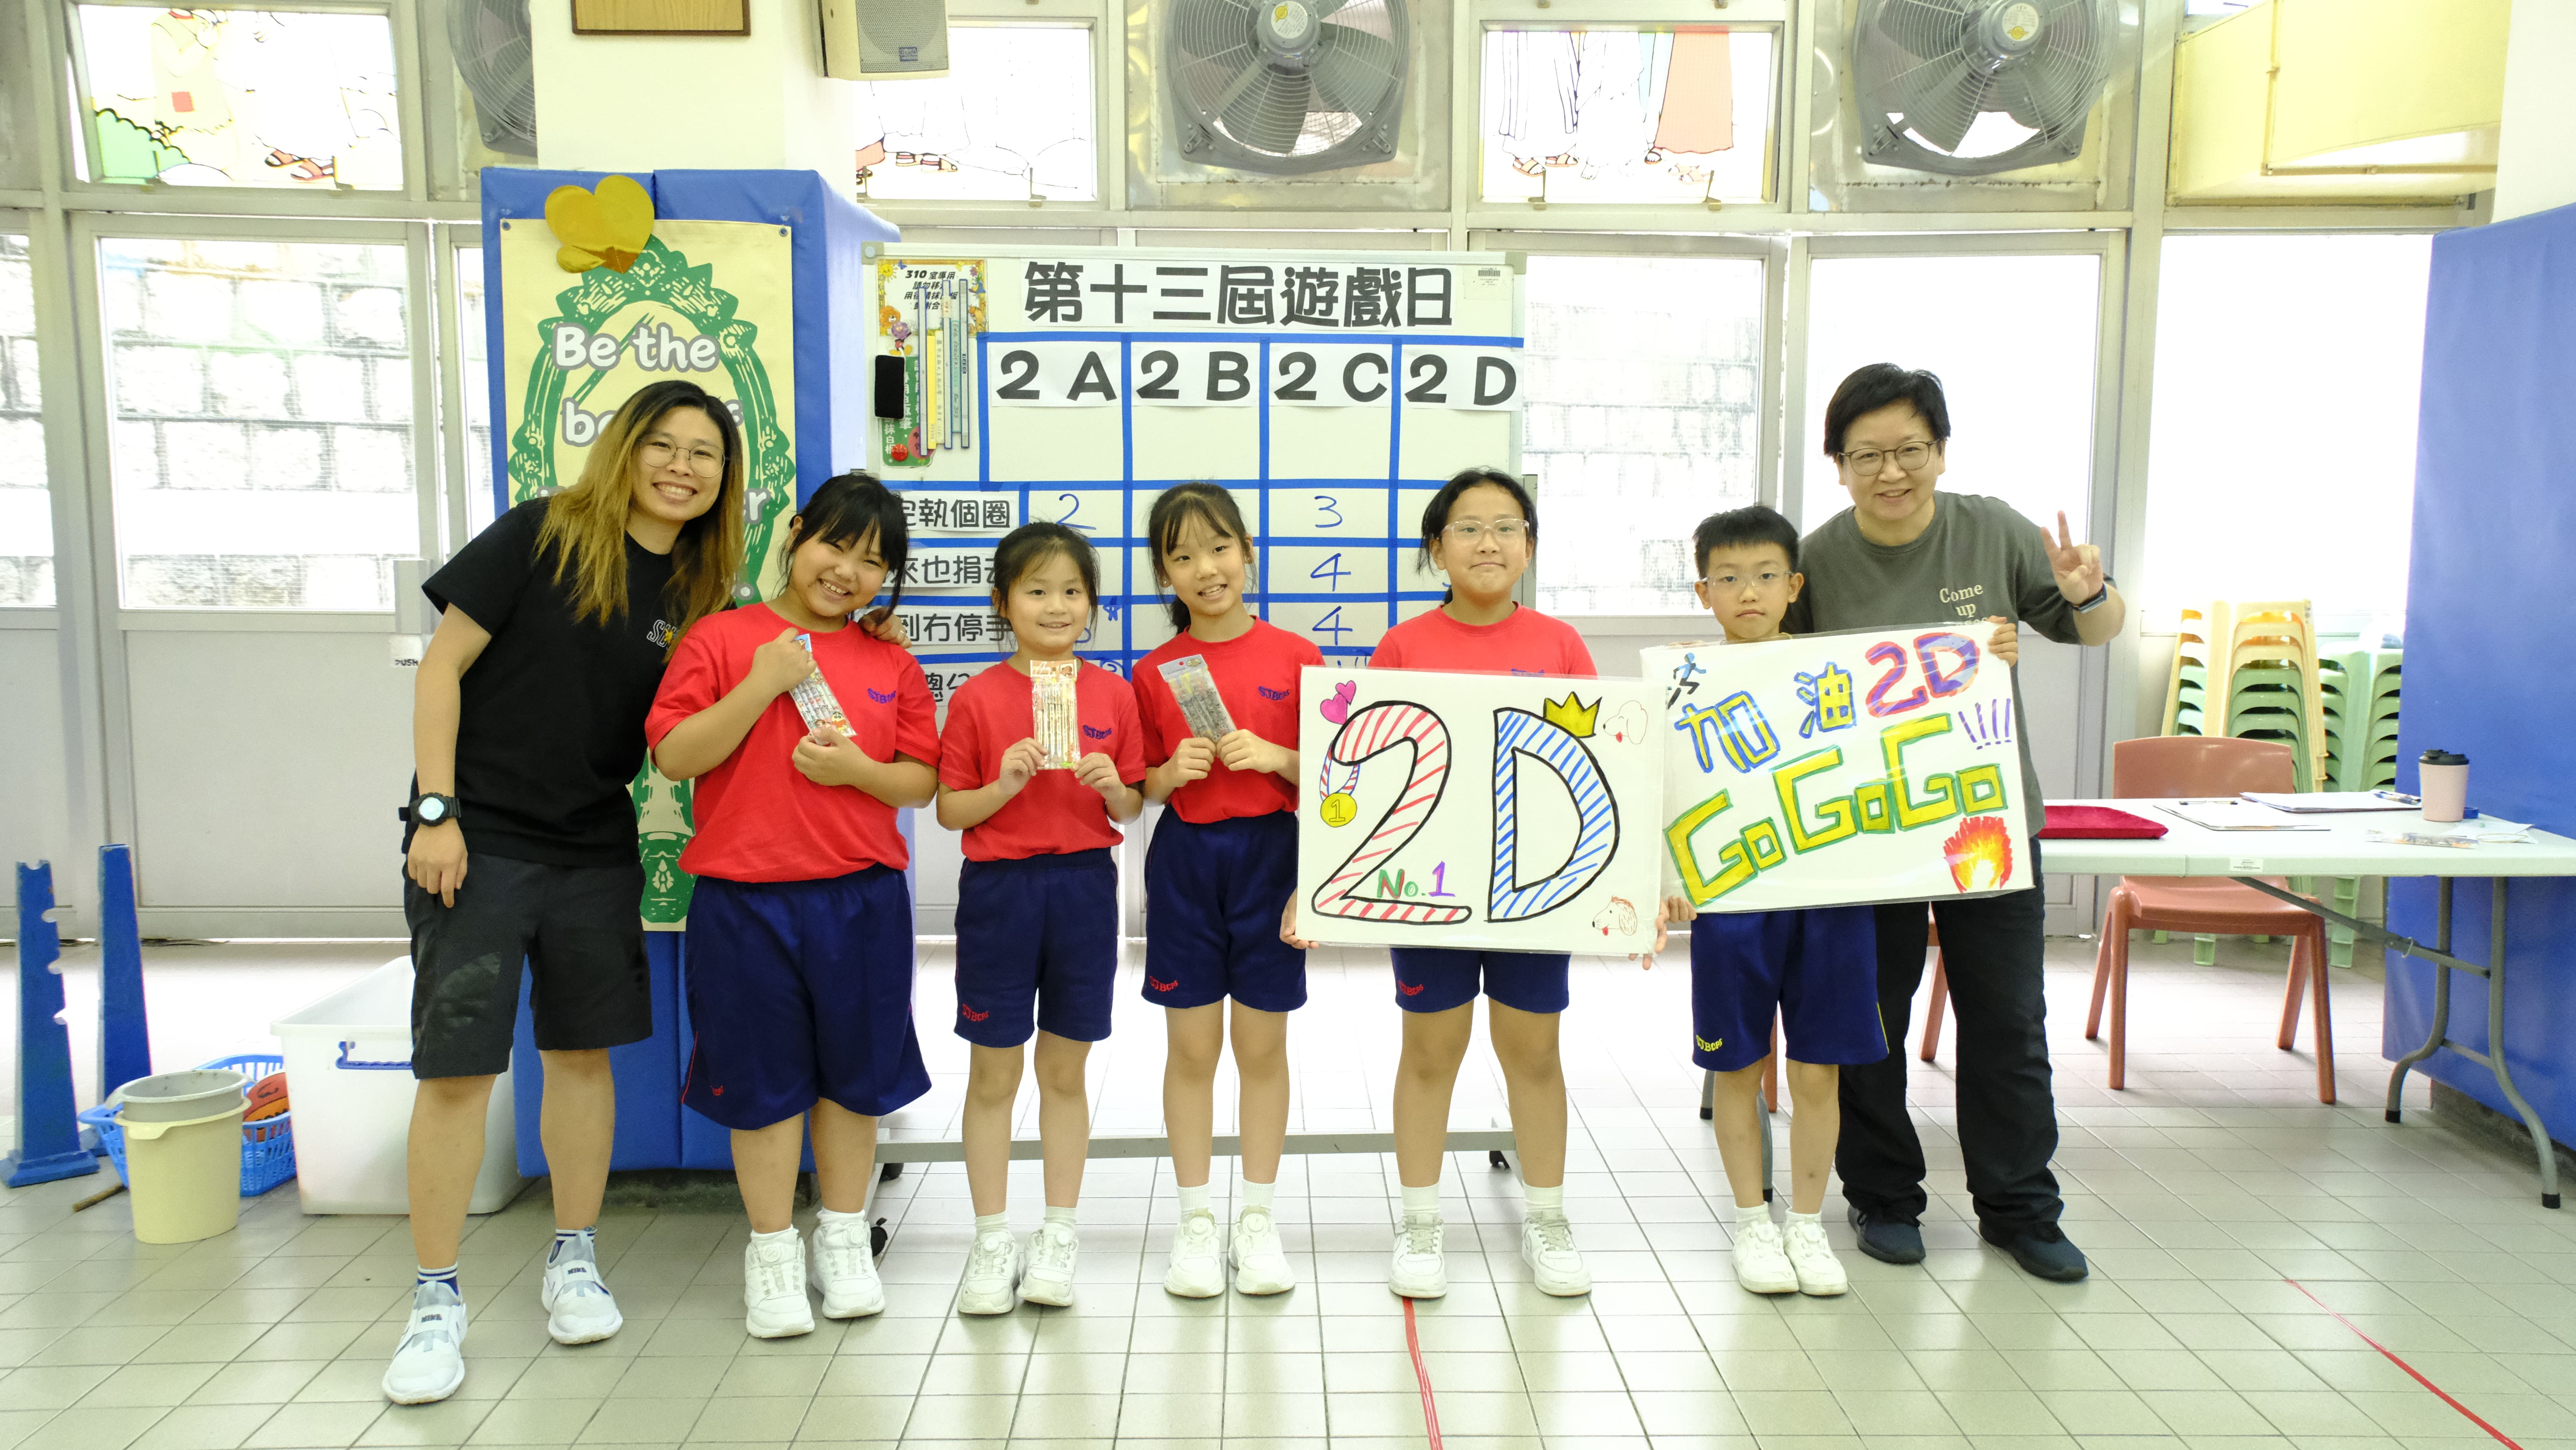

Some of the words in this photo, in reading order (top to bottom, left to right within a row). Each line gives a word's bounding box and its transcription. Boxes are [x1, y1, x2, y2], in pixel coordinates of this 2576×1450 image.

[906, 270, 927, 279] 310
[1025, 261, 1452, 327] 第十三屆遊戲日
[554, 323, 620, 370] Be
[630, 323, 719, 371] the
[1057, 494, 1096, 530] 2
[1315, 496, 1342, 528] 3
[1310, 553, 1351, 591] 4
[1939, 585, 1983, 603] Come
[1955, 604, 1976, 618] up
[1312, 606, 1353, 646] 4
[1674, 661, 1857, 773] 加油
[1865, 632, 1980, 718] 2D
[1331, 799, 1345, 822] 1
